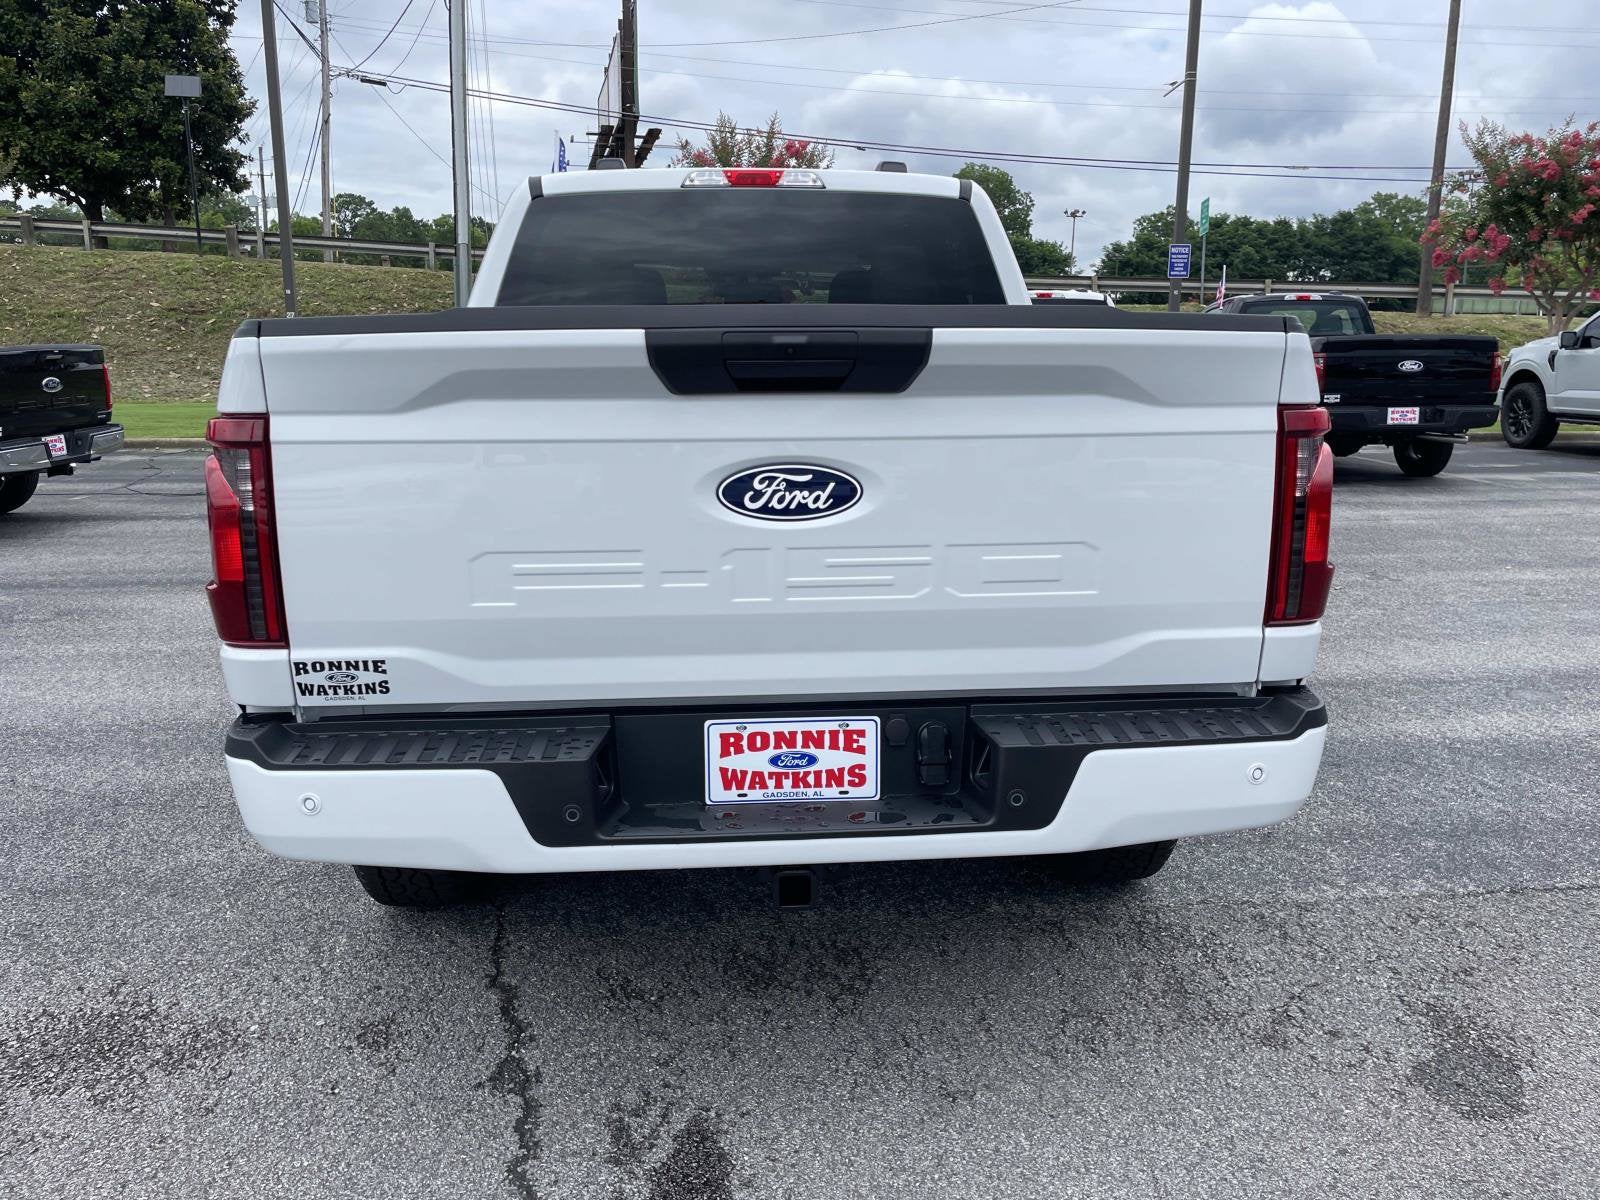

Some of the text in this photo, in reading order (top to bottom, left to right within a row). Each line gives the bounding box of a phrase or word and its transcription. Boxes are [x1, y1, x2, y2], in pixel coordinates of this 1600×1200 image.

[743, 472, 836, 510] Ford
[468, 541, 1100, 606] F-150
[293, 660, 388, 677] RONNIE
[296, 680, 391, 697] WATKINS
[719, 729, 867, 759] RONNIE
[778, 753, 809, 767] Ford
[718, 763, 867, 791] WATKINS
[812, 790, 824, 798] AL
